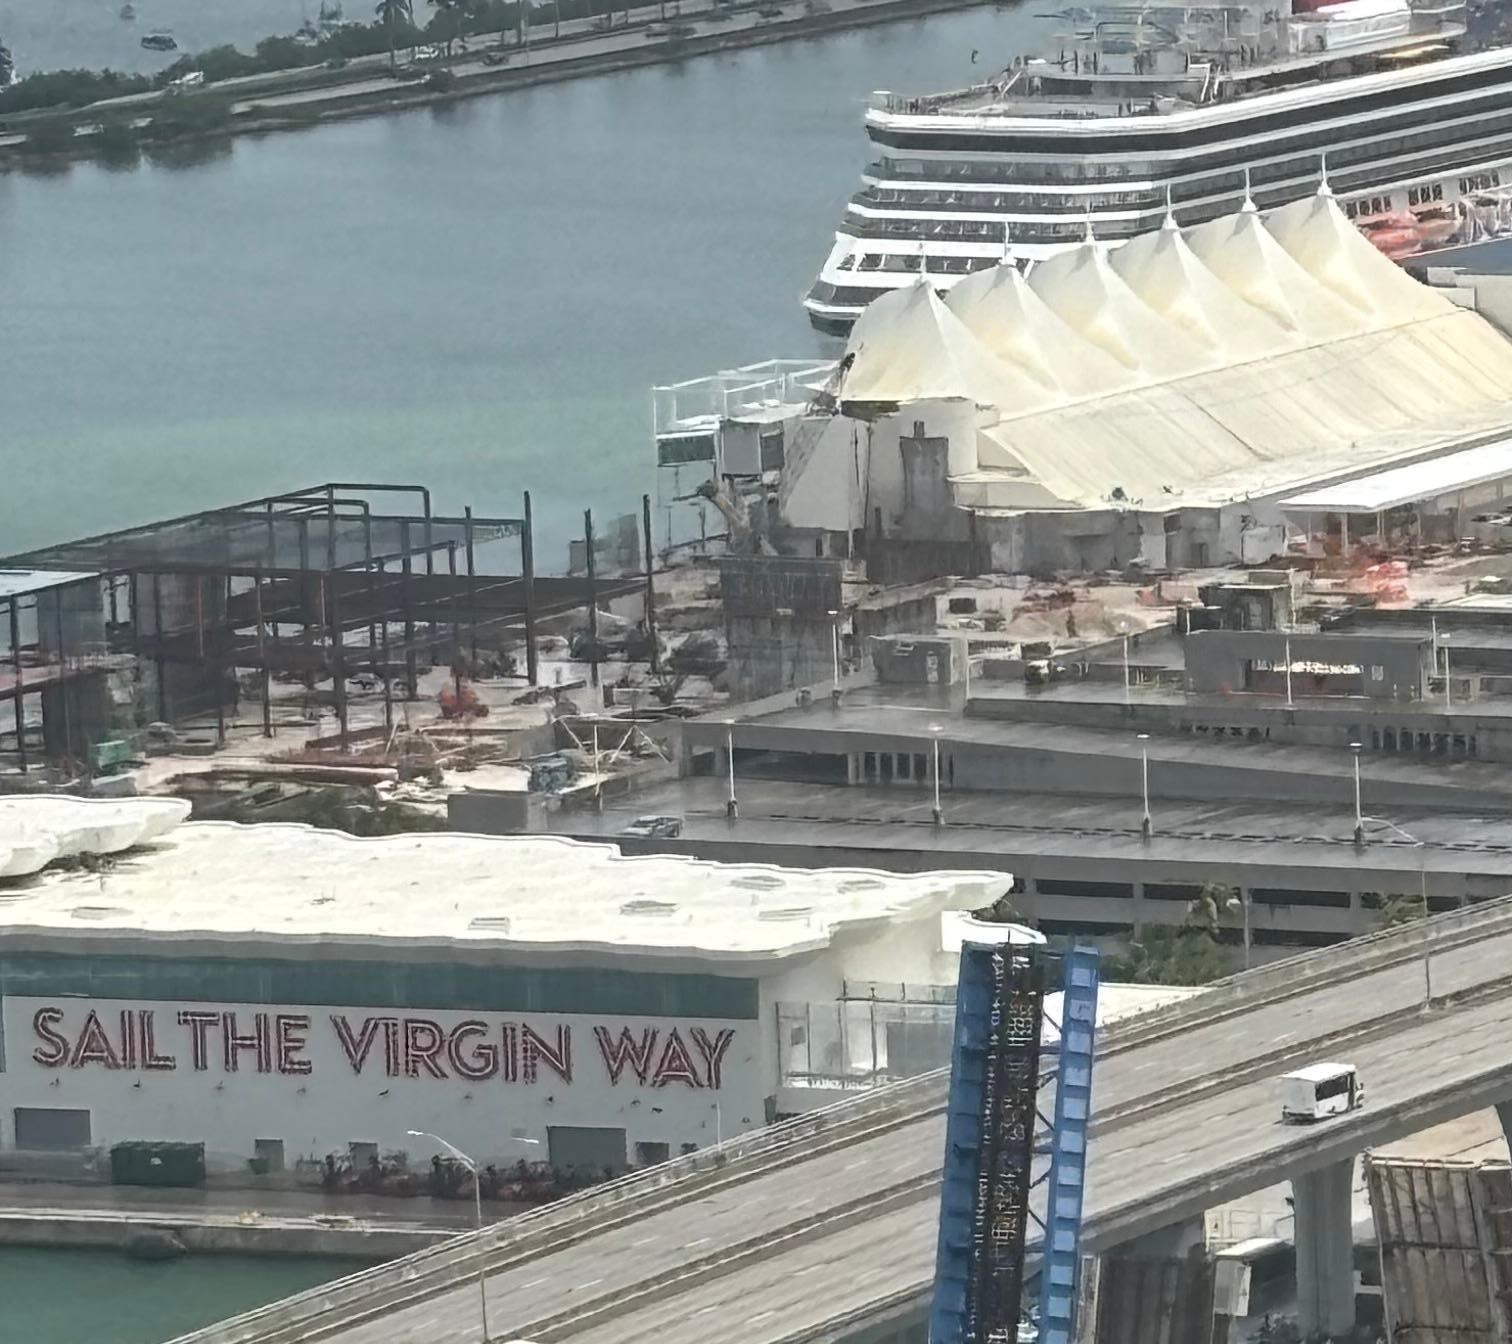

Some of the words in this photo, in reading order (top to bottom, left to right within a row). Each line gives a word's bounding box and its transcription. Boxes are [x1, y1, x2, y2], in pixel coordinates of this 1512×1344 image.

[32, 1006, 176, 1071] SAIL
[178, 1010, 312, 1075] THE
[329, 1014, 573, 1086] VIRGIN
[593, 1023, 736, 1090] WAY
